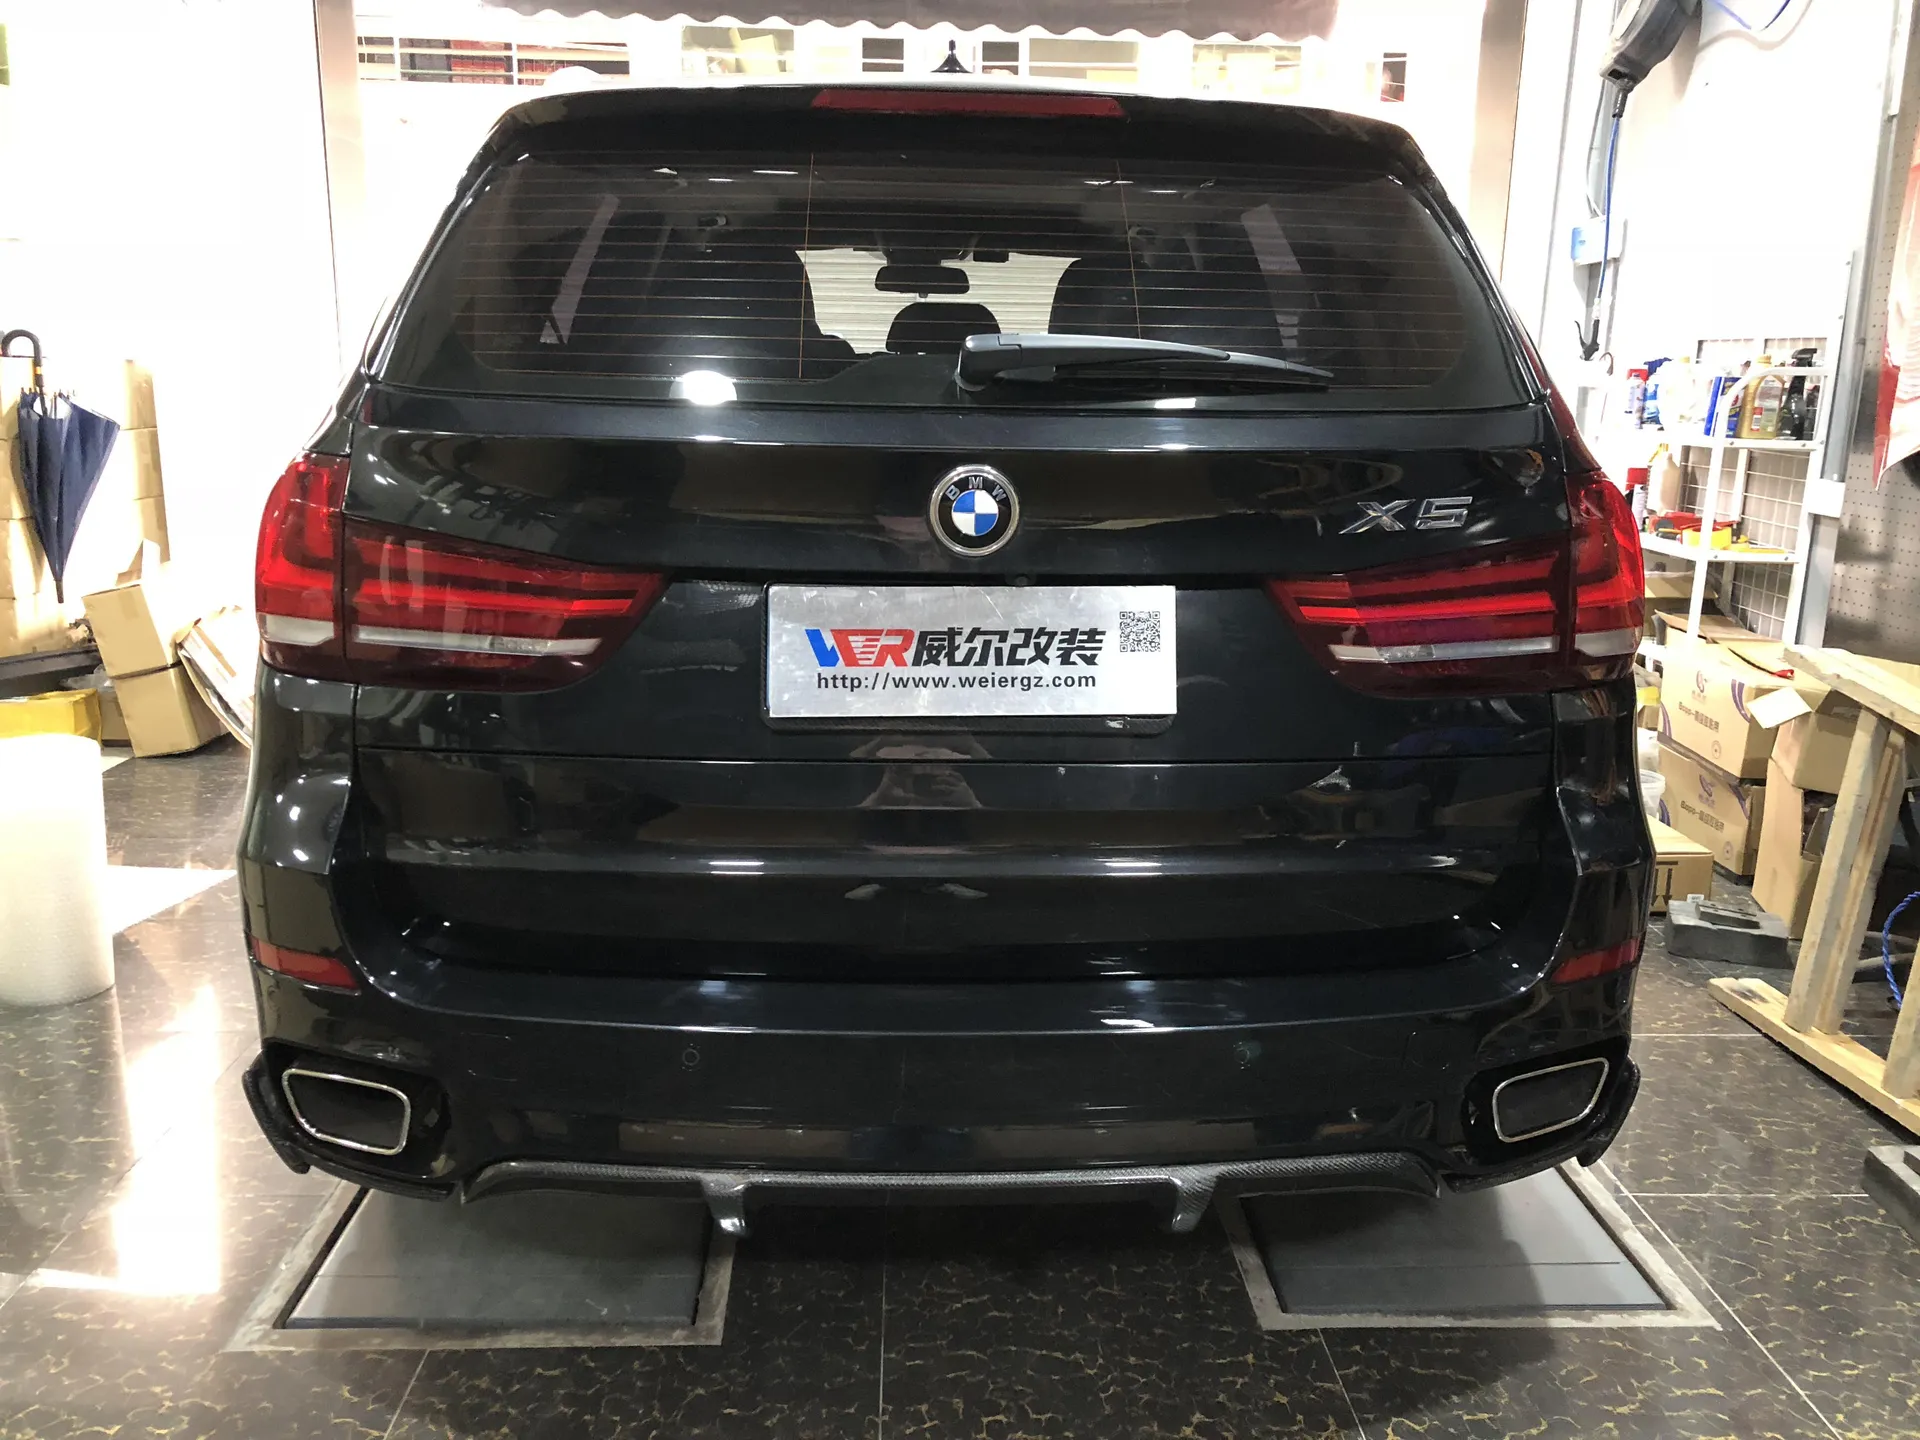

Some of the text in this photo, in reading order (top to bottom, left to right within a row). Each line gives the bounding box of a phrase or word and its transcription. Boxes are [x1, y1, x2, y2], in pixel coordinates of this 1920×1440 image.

[945, 476, 1007, 502] BMW
[1338, 496, 1473, 534] X5
[911, 626, 1106, 667] 威尔改装
[817, 672, 1096, 692] http://www.weiergz.com
